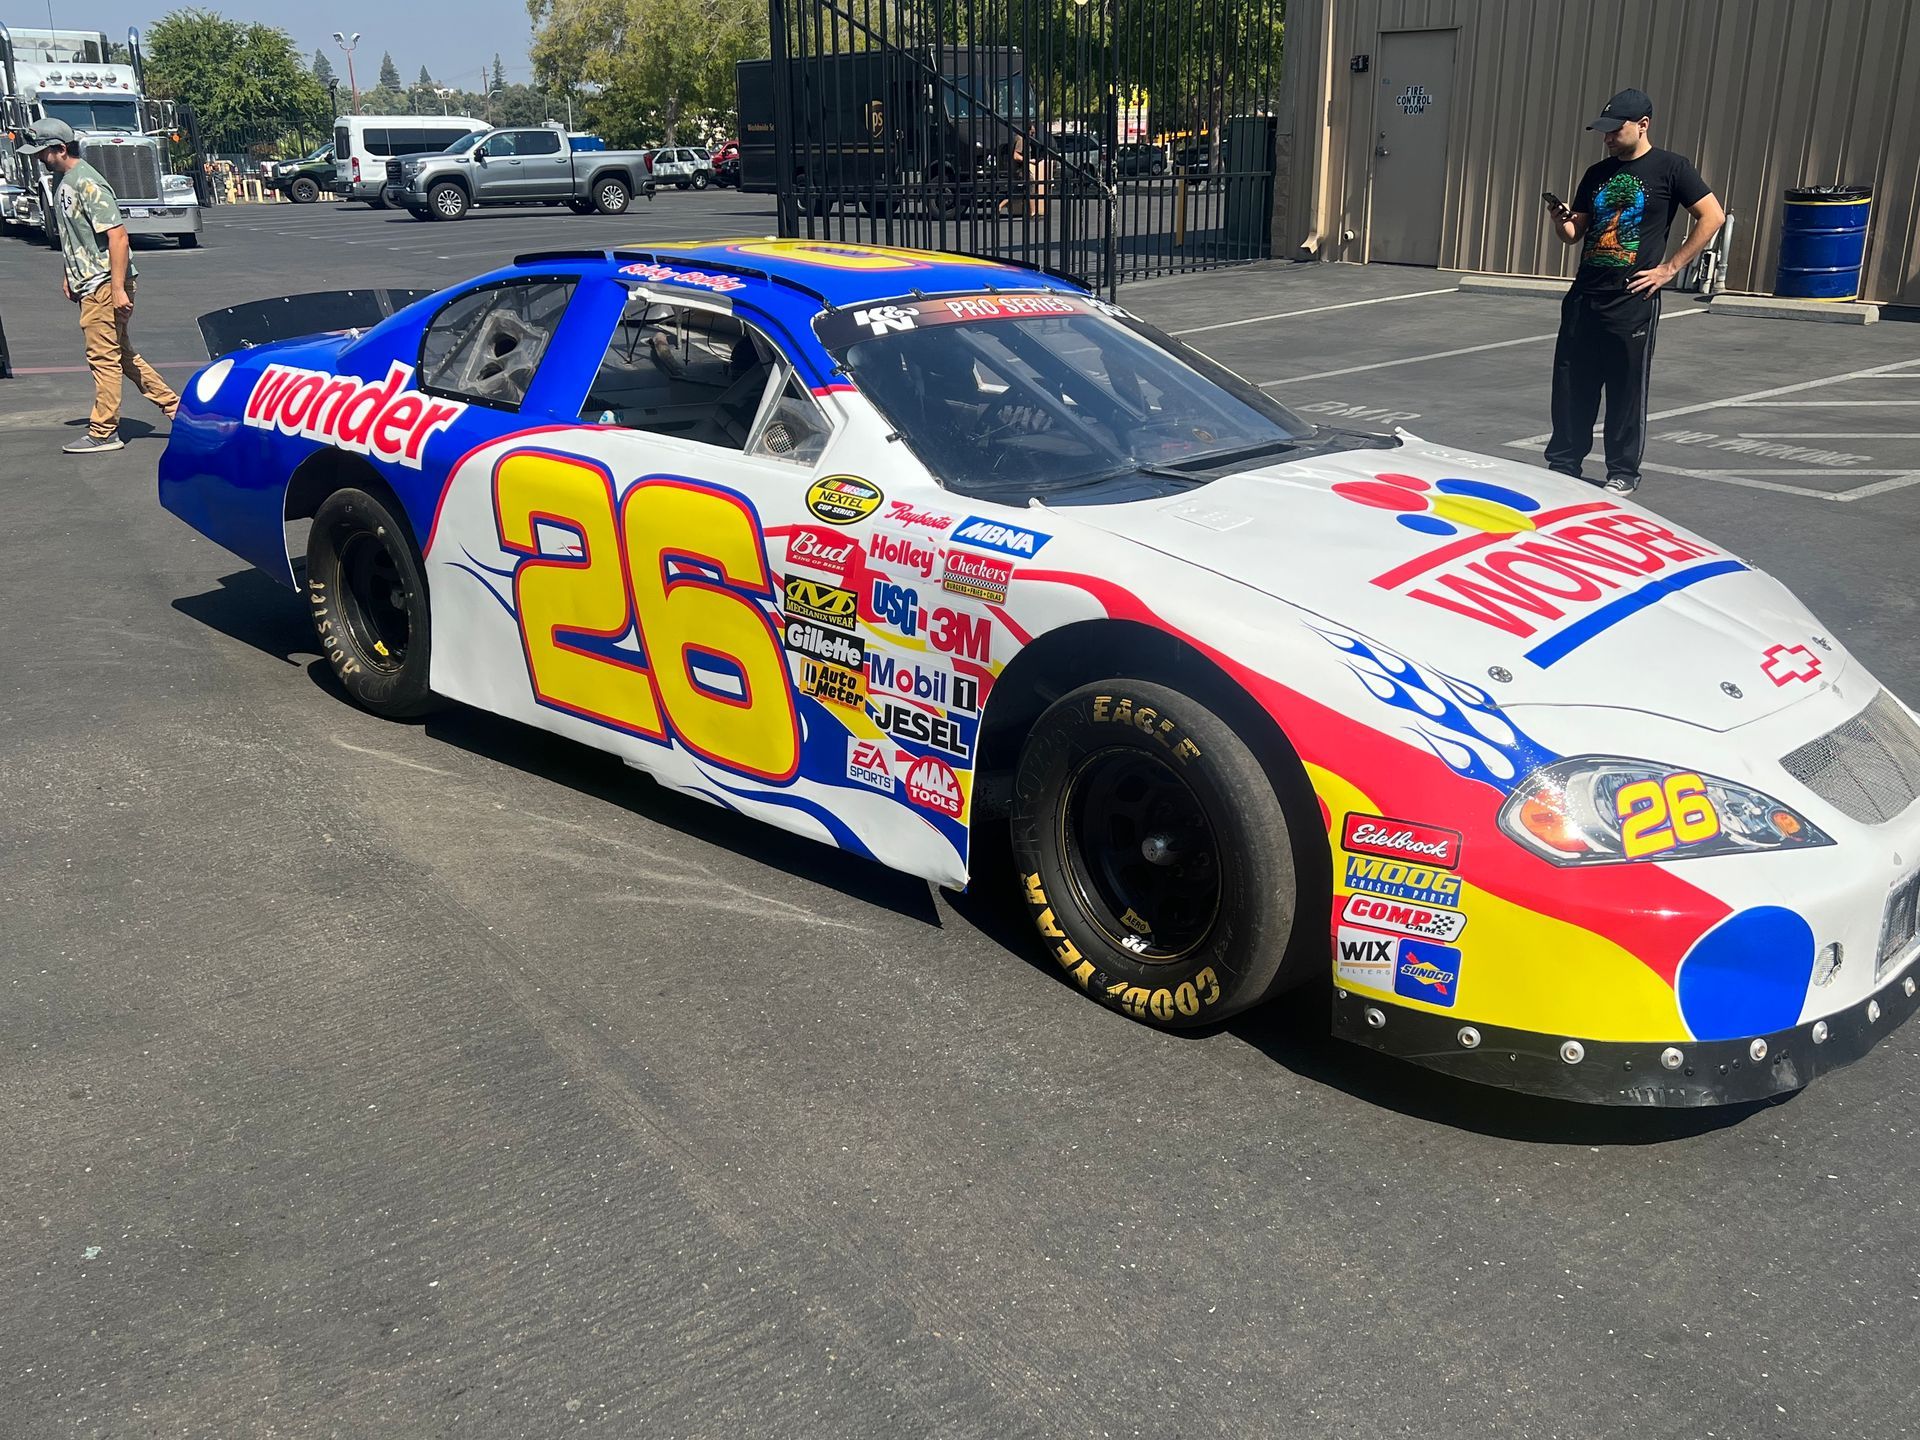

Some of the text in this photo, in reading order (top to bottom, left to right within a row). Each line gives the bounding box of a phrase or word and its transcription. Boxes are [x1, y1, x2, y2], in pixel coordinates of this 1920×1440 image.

[1396, 95, 1432, 105] CONTROL
[1405, 86, 1424, 95] FIRE
[1403, 105, 1424, 114] ROOM
[853, 306, 919, 336] K&N
[945, 296, 1074, 318] PRO SERIES
[246, 367, 461, 461] wonder
[1651, 430, 1874, 467] NO PARKING
[817, 503, 856, 517] CUP SERIES
[818, 490, 863, 509] NEXTEL
[791, 530, 855, 563] Bud
[957, 522, 1035, 553] MBNA
[870, 533, 934, 578] Holley
[948, 554, 1008, 582] Checkers
[1405, 514, 1720, 639] WONDER
[946, 582, 1002, 601] BURGERS FRIES COLAS
[493, 446, 800, 788] 26
[786, 599, 854, 629] MECHANIX WEAR
[873, 580, 918, 636] USG
[787, 623, 860, 666] Gillette
[930, 607, 992, 664] 3M
[819, 666, 857, 690] Auto
[871, 652, 947, 703] Mobil
[815, 680, 864, 706] Meter
[875, 703, 967, 756] JESEL
[851, 741, 889, 775] EA
[850, 765, 891, 789] SPORTS
[911, 761, 959, 800] MAC
[910, 787, 958, 812] TOOLS
[1616, 771, 1720, 861] 26
[1352, 823, 1449, 858] Edelbrock
[1348, 858, 1460, 894] MOOG
[1351, 878, 1453, 906] CHASSIS PARTS
[1125, 913, 1147, 931] AERO
[1350, 899, 1432, 926] COMP
[1405, 923, 1446, 936] CAMS
[1340, 940, 1392, 961] WIX
[1340, 967, 1391, 976] FILTERS
[1401, 965, 1452, 983] SUNOCO
